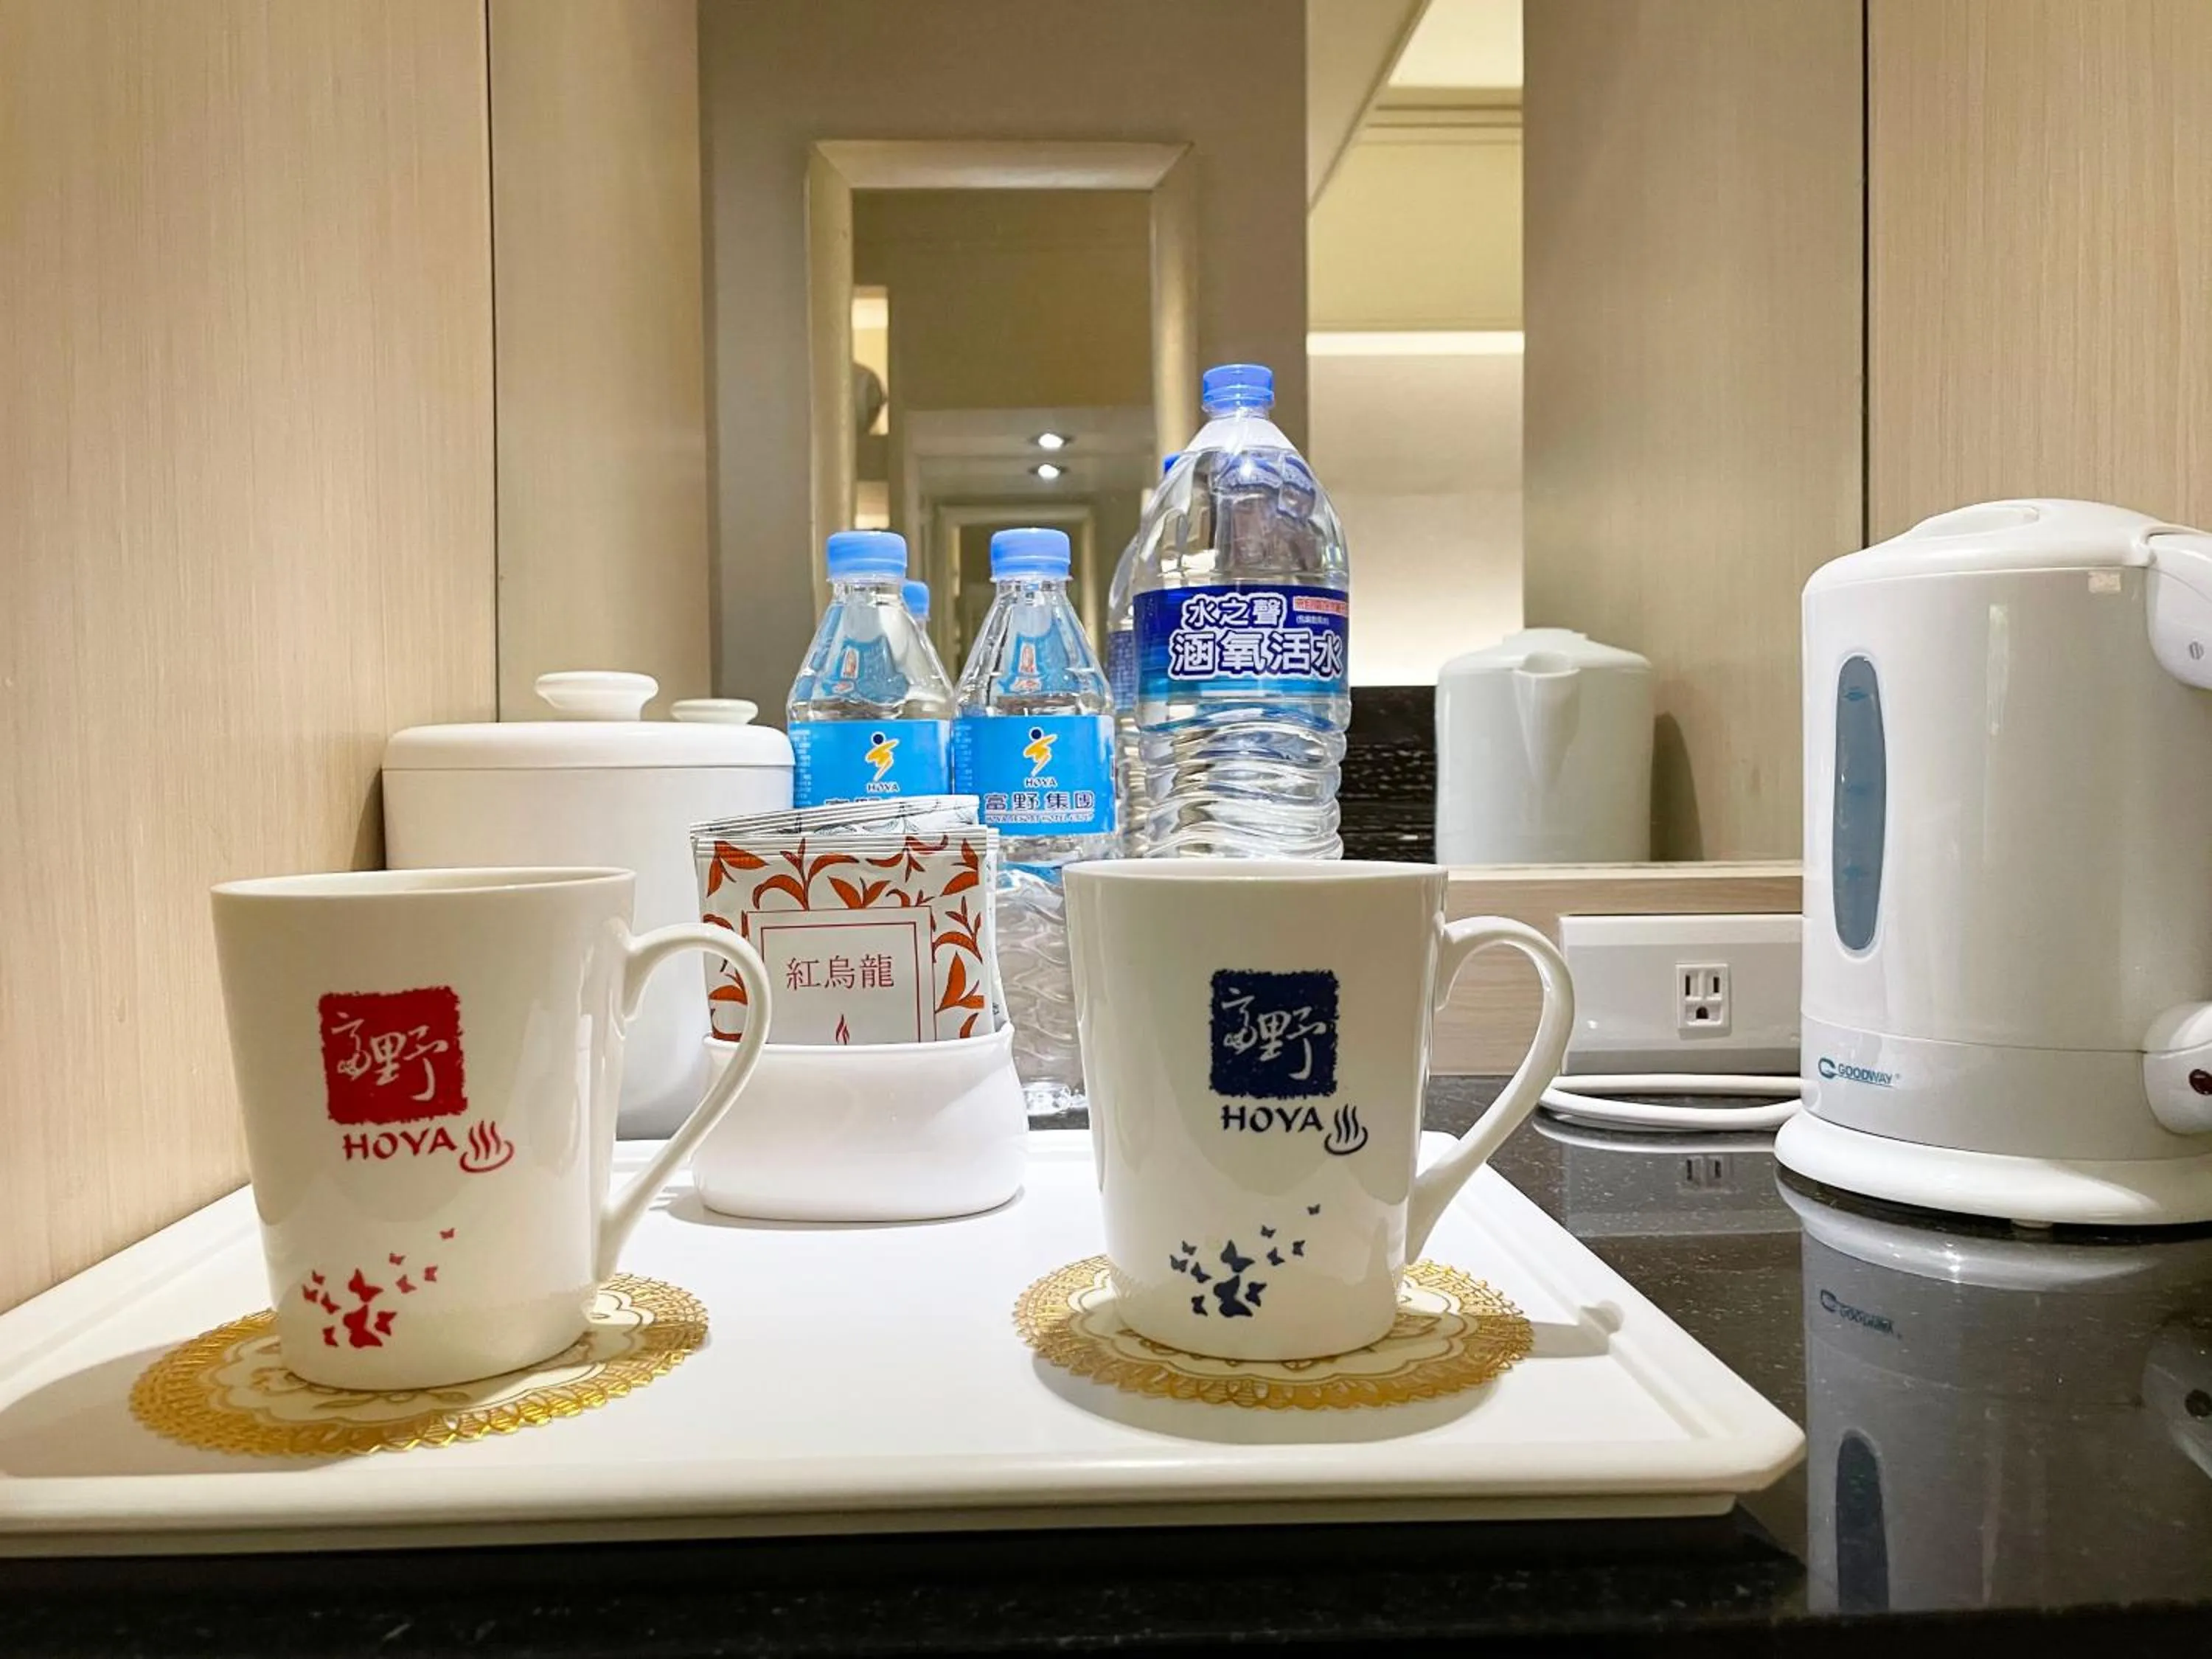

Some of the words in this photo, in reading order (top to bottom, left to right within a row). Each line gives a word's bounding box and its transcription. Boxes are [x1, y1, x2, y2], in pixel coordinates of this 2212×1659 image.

[1184, 595, 1283, 626] 水之聲
[1174, 630, 1343, 675] 涵氧活水
[986, 791, 1093, 810] 富野集團
[785, 955, 894, 990] 紅烏龍
[1838, 1064, 1893, 1084] GOODWAY
[1221, 1105, 1323, 1132] HOYA
[343, 1127, 457, 1161] HOYA
